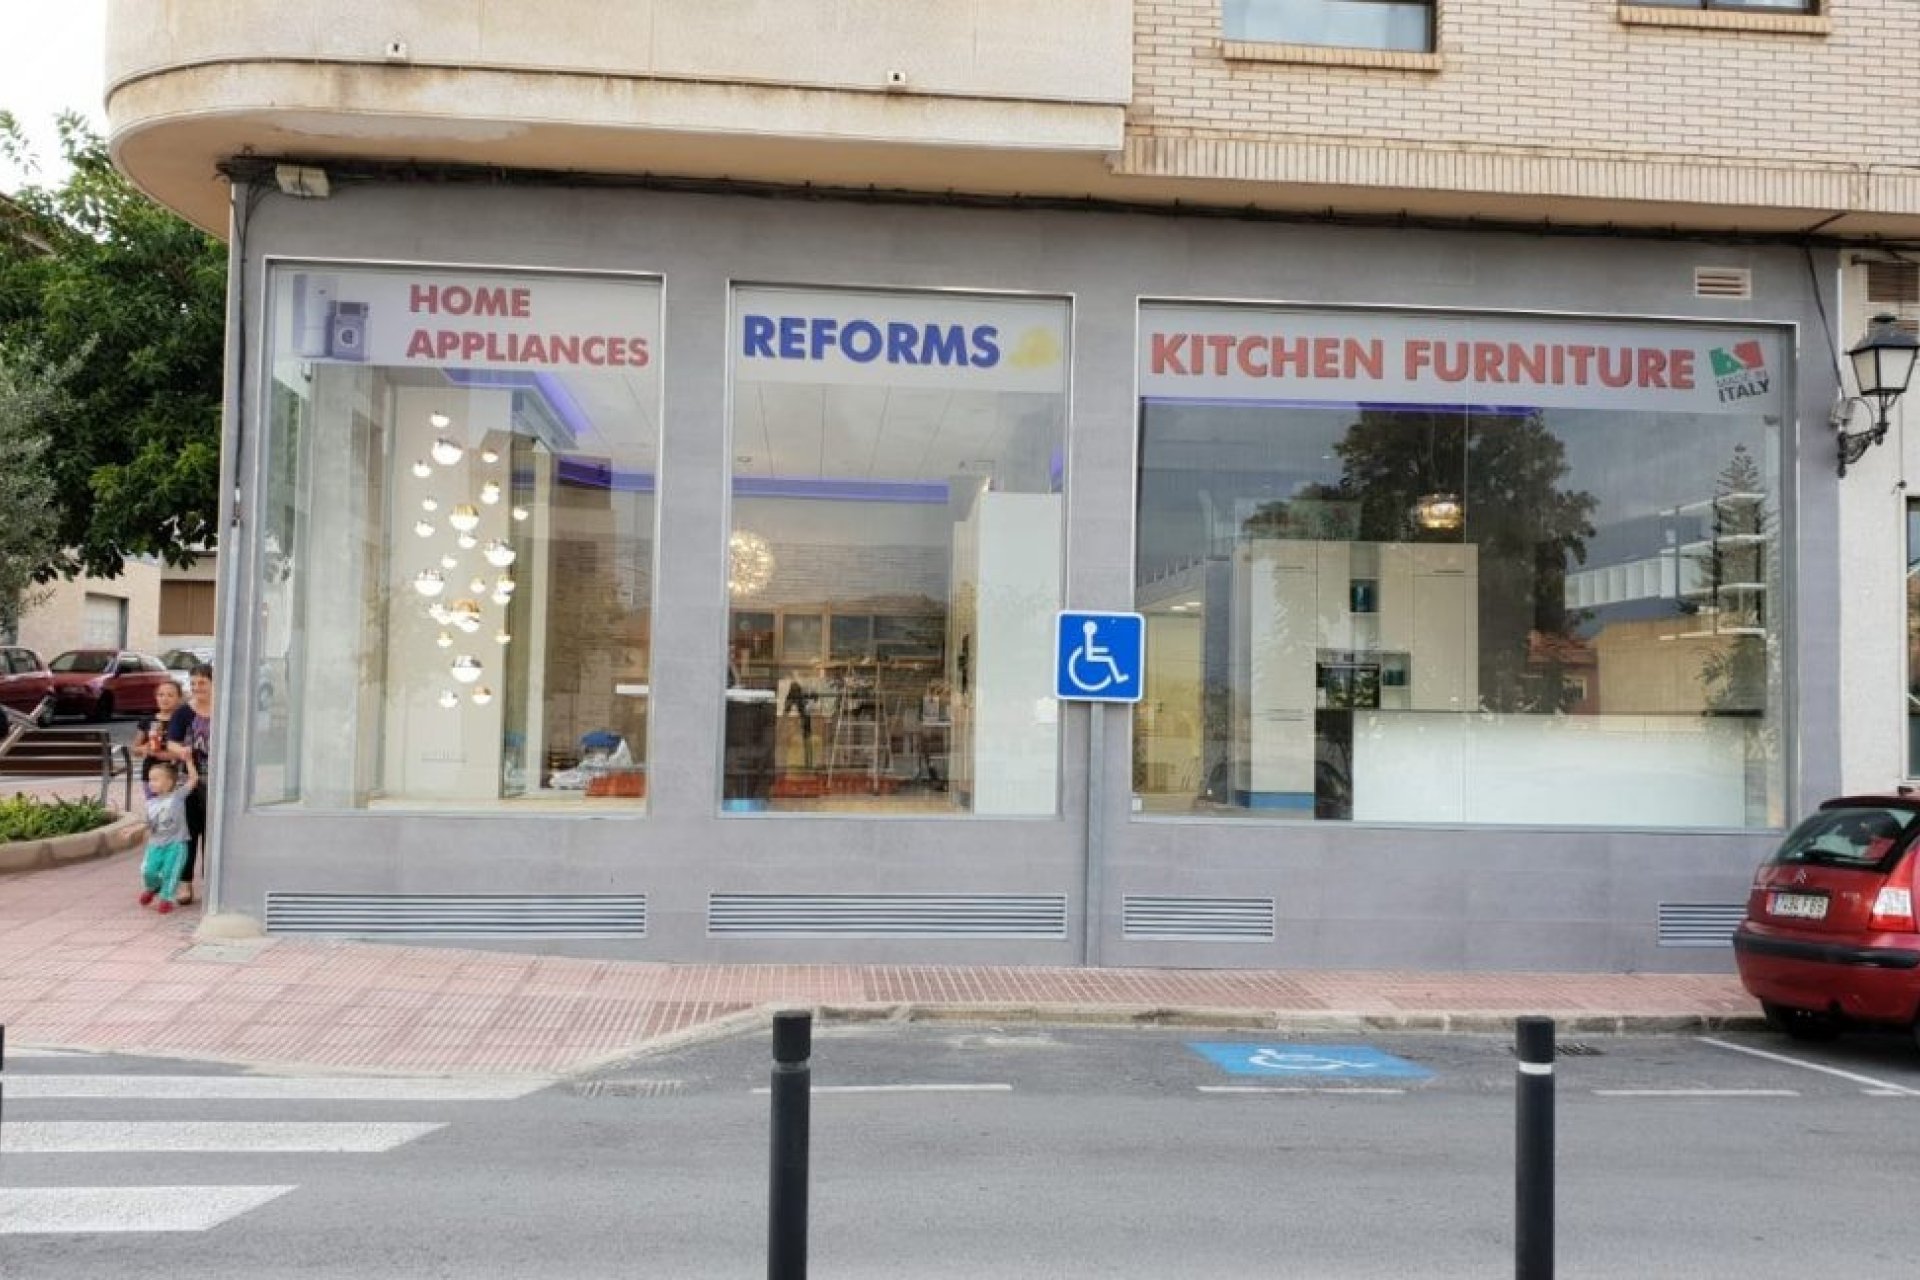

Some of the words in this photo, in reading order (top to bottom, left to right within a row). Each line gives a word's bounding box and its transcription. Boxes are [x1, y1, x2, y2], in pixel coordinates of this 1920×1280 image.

[410, 285, 529, 319] HOME
[407, 329, 649, 368] APPLIANCES
[744, 315, 1000, 368] REFORMS
[1151, 333, 1384, 380] KITCHEN
[1404, 338, 1696, 390] FURNITURE
[1718, 379, 1769, 403] ITALY
